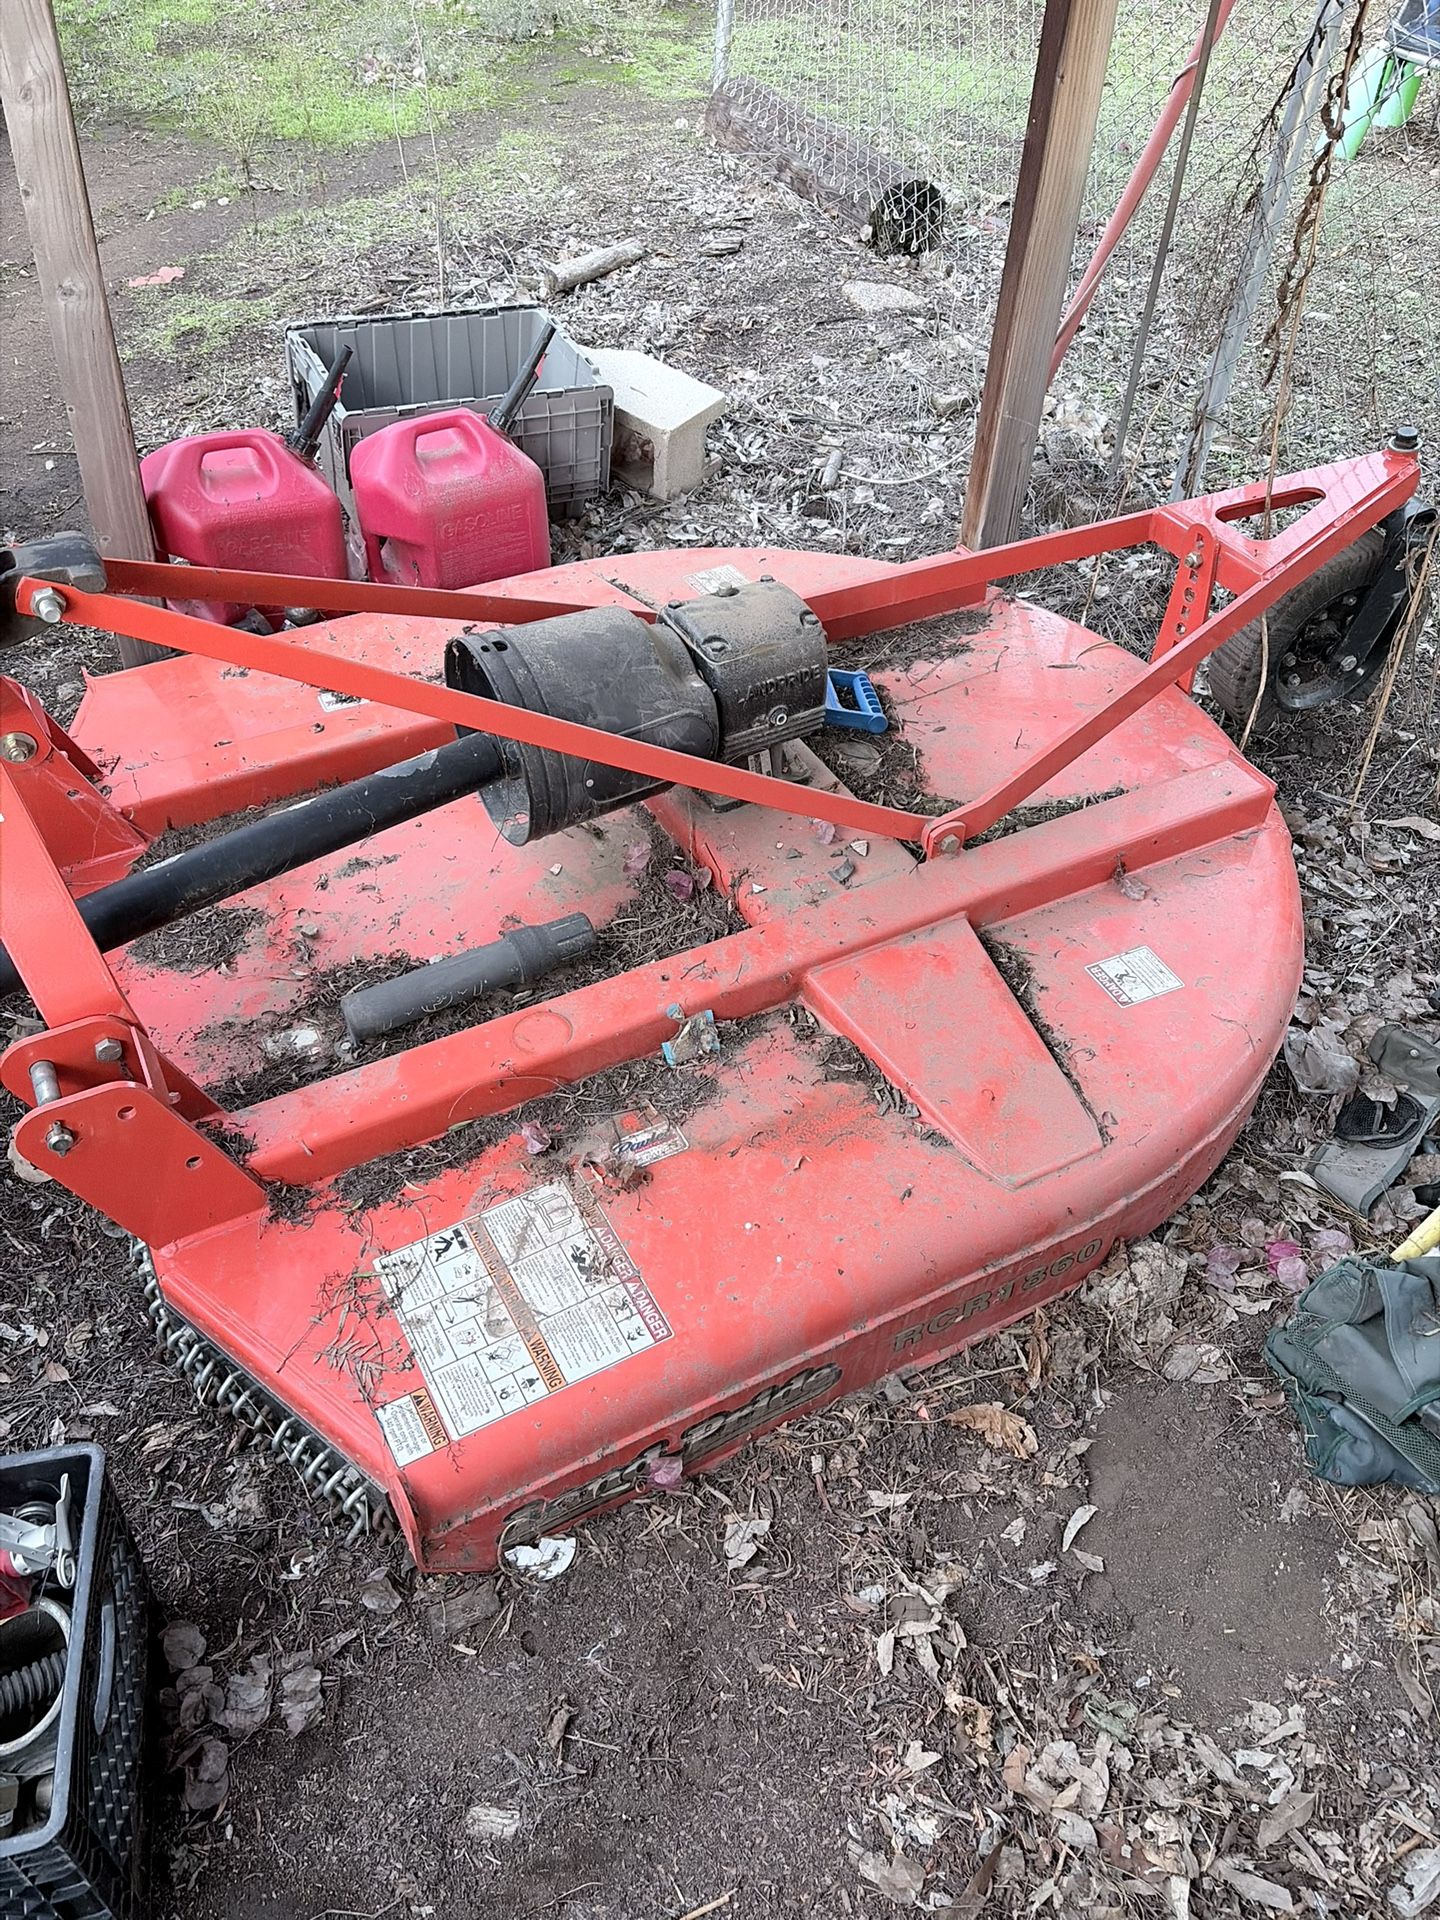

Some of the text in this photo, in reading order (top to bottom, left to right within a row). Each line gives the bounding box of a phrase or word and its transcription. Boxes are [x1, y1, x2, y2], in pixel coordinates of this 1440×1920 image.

[441, 503, 523, 539] GASOLINE
[1090, 966, 1122, 996] DANGER
[599, 1233, 634, 1279] DANGER
[497, 1279, 532, 1326] WARING
[631, 1290, 669, 1339] DANGER
[893, 1238, 1104, 1353] RCR1860
[527, 1338, 563, 1389] WARNING
[388, 1409, 404, 1432] Operate
[417, 1401, 446, 1445] WARNING
